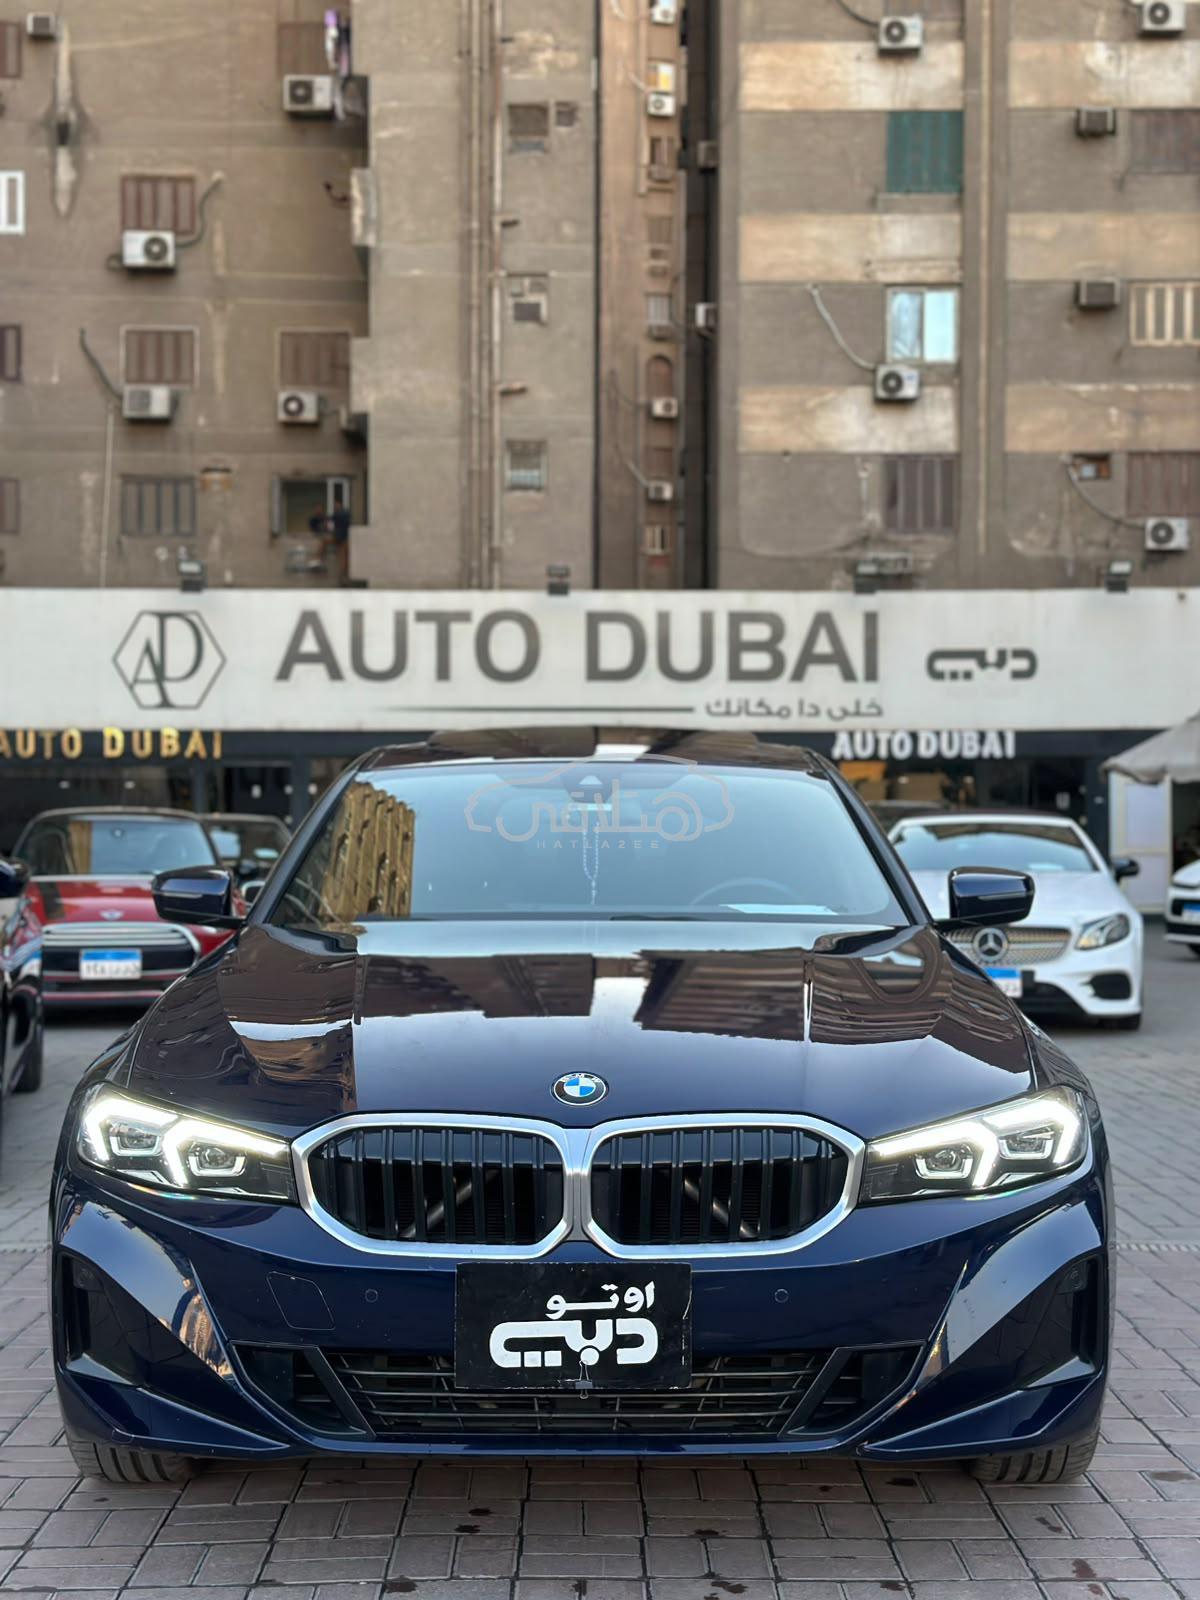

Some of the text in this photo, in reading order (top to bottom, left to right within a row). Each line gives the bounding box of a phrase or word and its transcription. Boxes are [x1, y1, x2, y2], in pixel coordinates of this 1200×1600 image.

[274, 609, 880, 684] AUTO DUBAI
[705, 697, 792, 719] مكانك
[102, 727, 223, 760] DUBAI
[831, 730, 1016, 760] AUTO DUBAI
[489, 1317, 659, 1369] دبي
